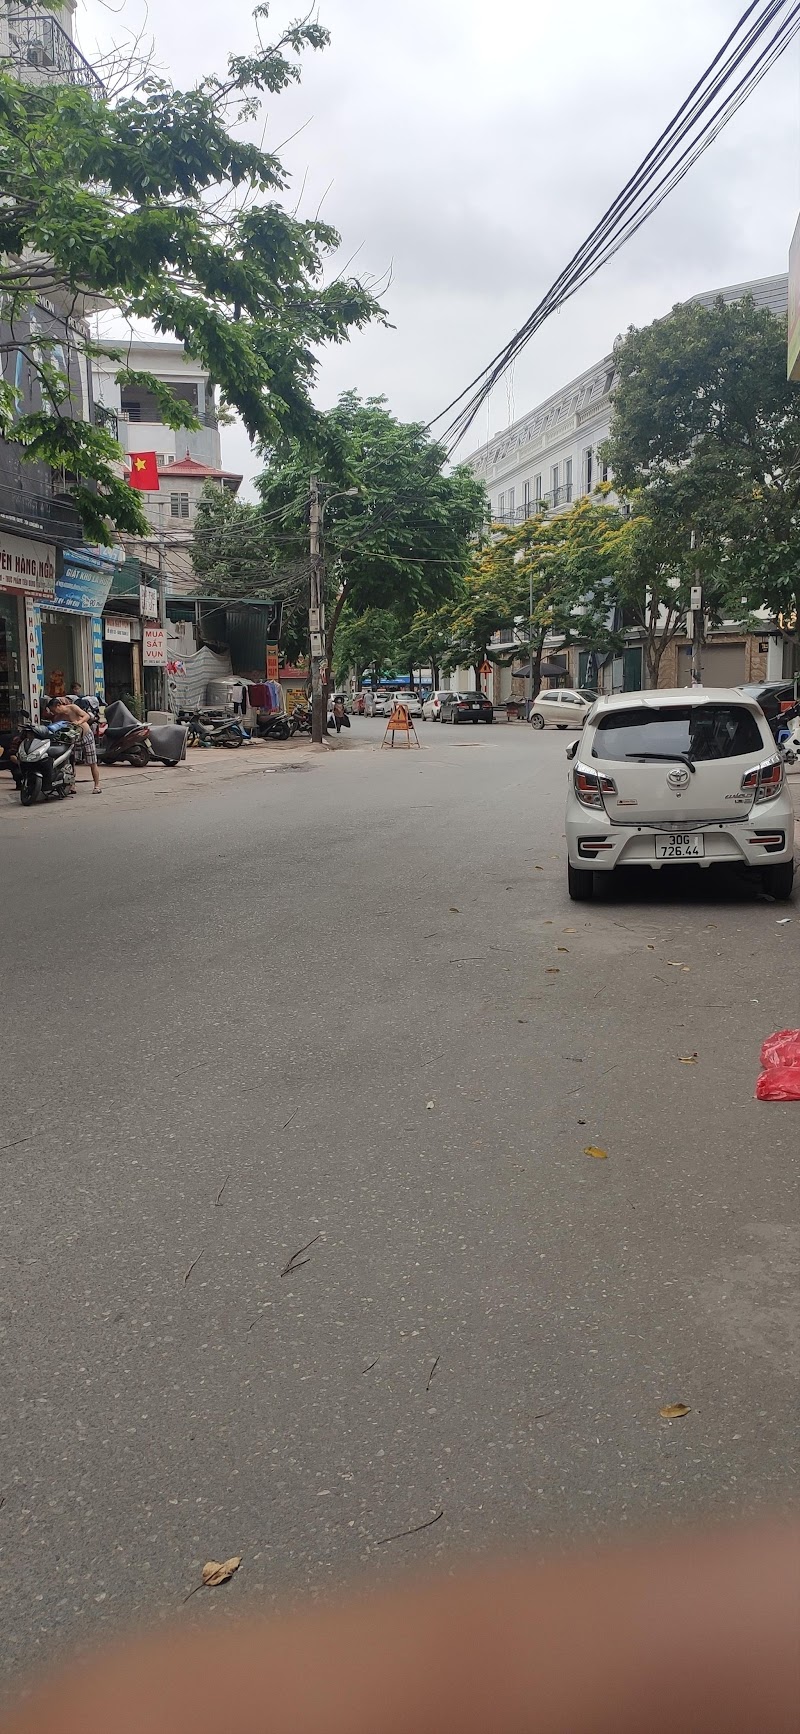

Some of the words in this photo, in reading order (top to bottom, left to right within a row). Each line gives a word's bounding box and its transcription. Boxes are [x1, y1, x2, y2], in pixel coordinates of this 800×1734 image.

[15, 554, 36, 576] HÀNG
[39, 560, 54, 579] NGA
[146, 638, 163, 647] SẮT
[669, 834, 690, 845] 30G
[661, 845, 699, 857] 726.44
